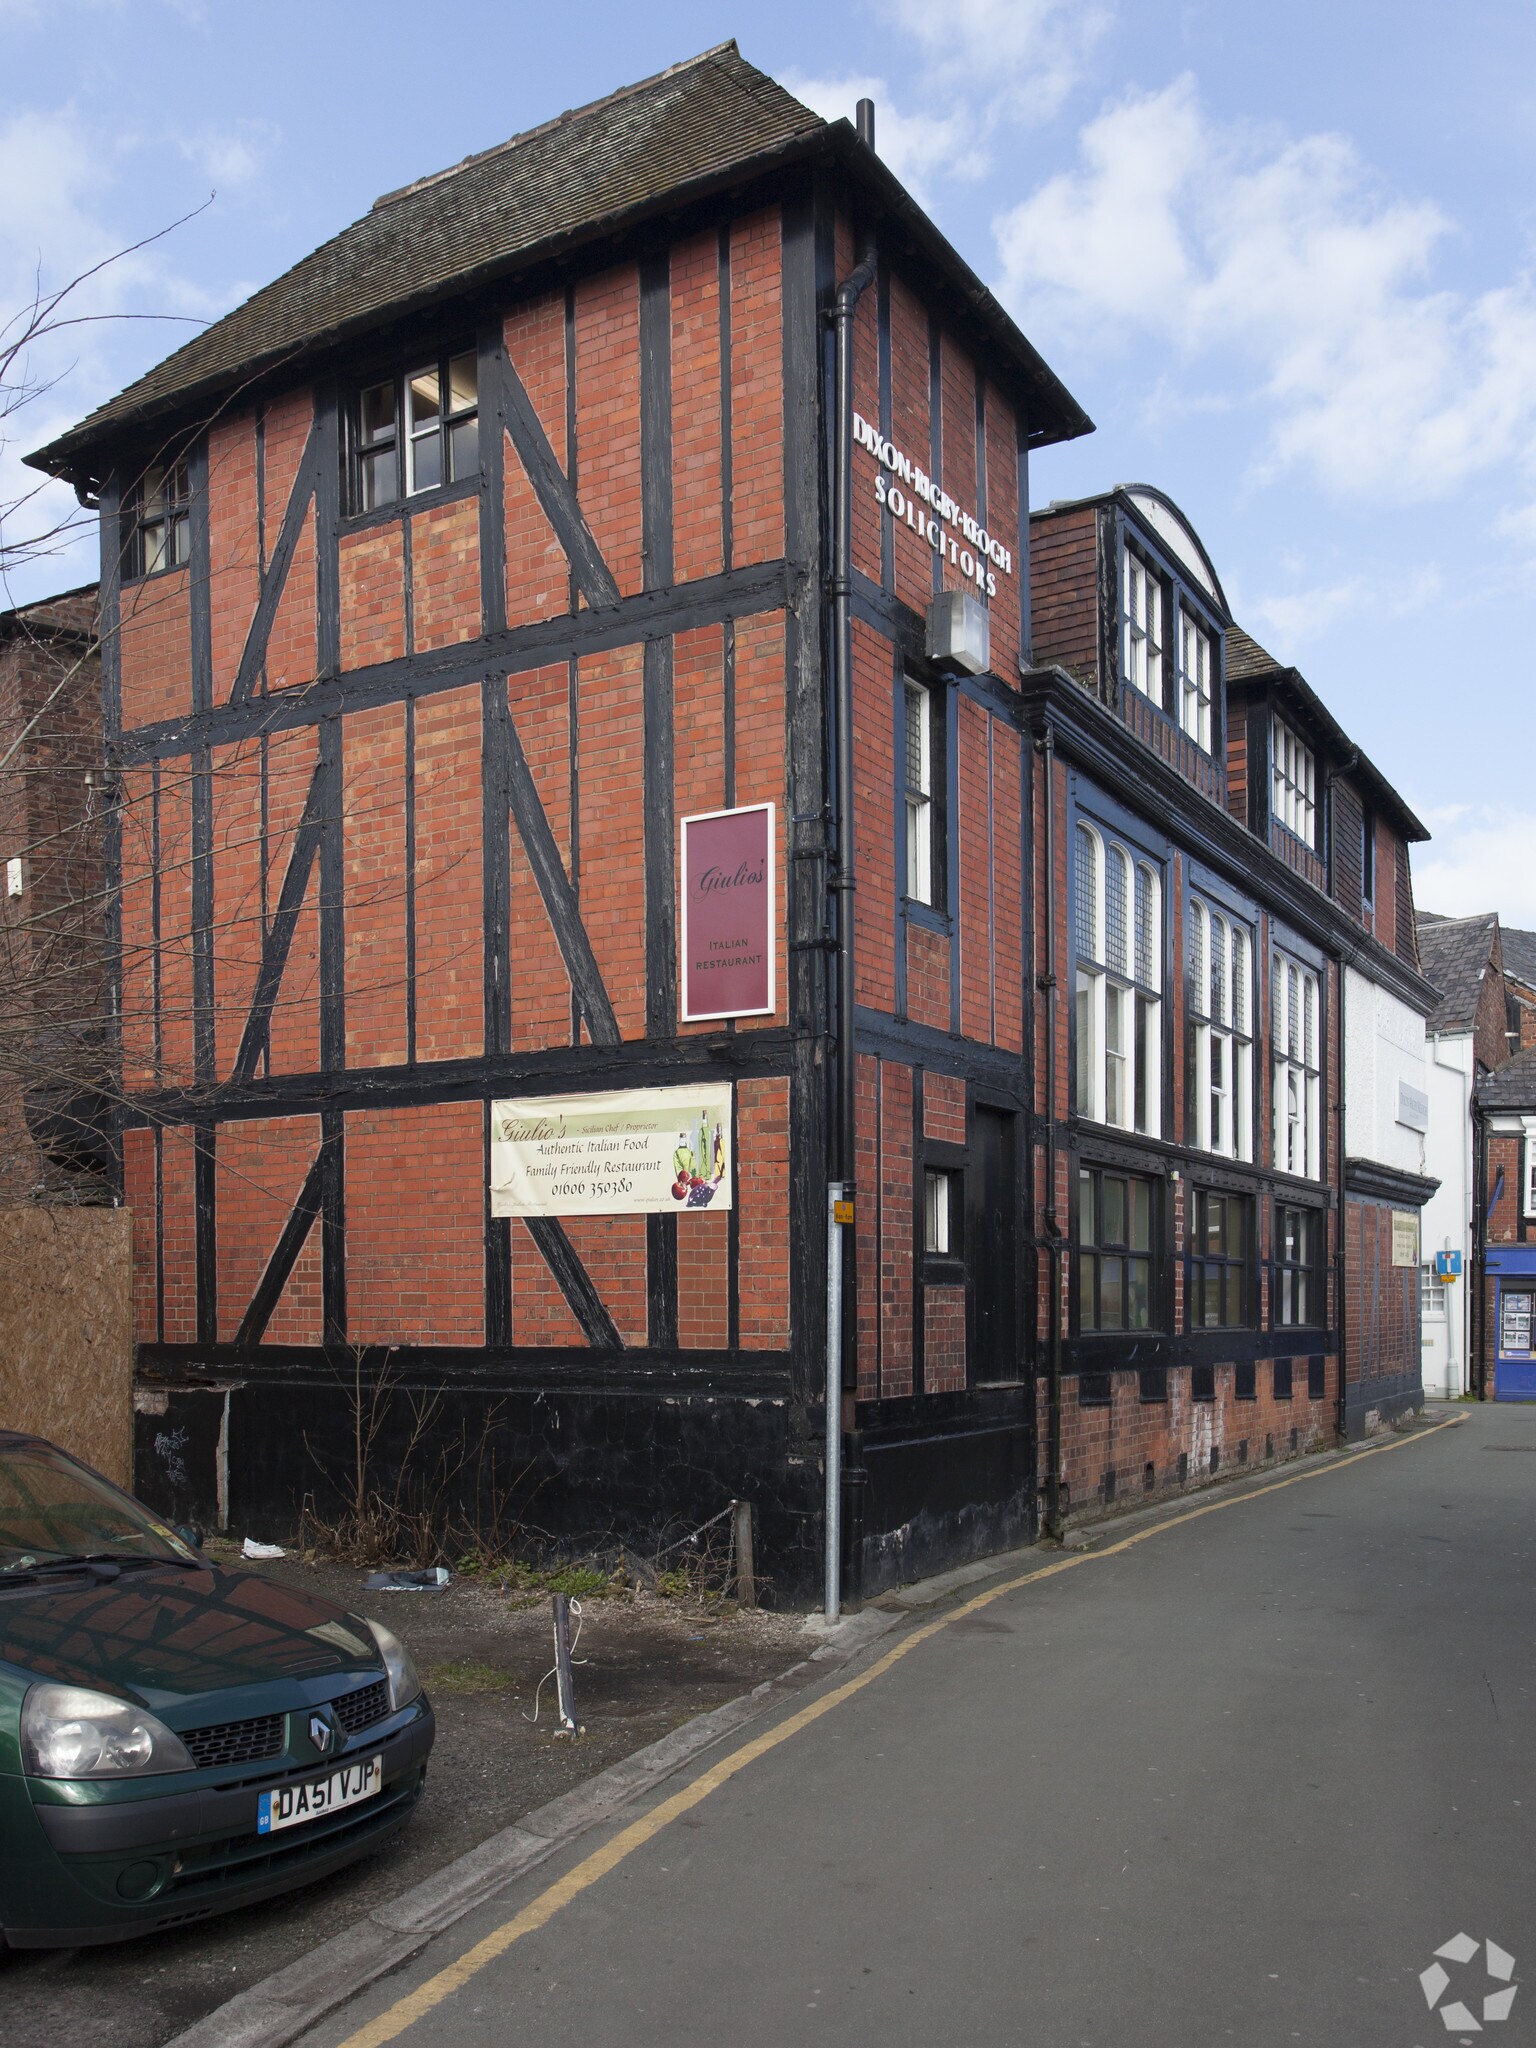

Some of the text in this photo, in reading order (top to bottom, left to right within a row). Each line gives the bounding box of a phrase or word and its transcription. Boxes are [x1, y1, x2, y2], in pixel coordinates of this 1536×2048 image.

[874, 475, 996, 597] SOLICITORS
[709, 939, 748, 950] ITALIAN
[696, 955, 762, 970] RESTAURANT
[498, 1114, 567, 1142] Giulio's
[605, 1123, 620, 1132] Chef
[626, 1123, 659, 1133] Proprietor
[536, 1136, 649, 1155] Authentic Italian Food
[526, 1160, 662, 1179] Family Friendly Restaurant
[551, 1178, 633, 1199] 01606 350380
[340, 1761, 374, 1800] VJP
[259, 1815, 270, 1826] GB
